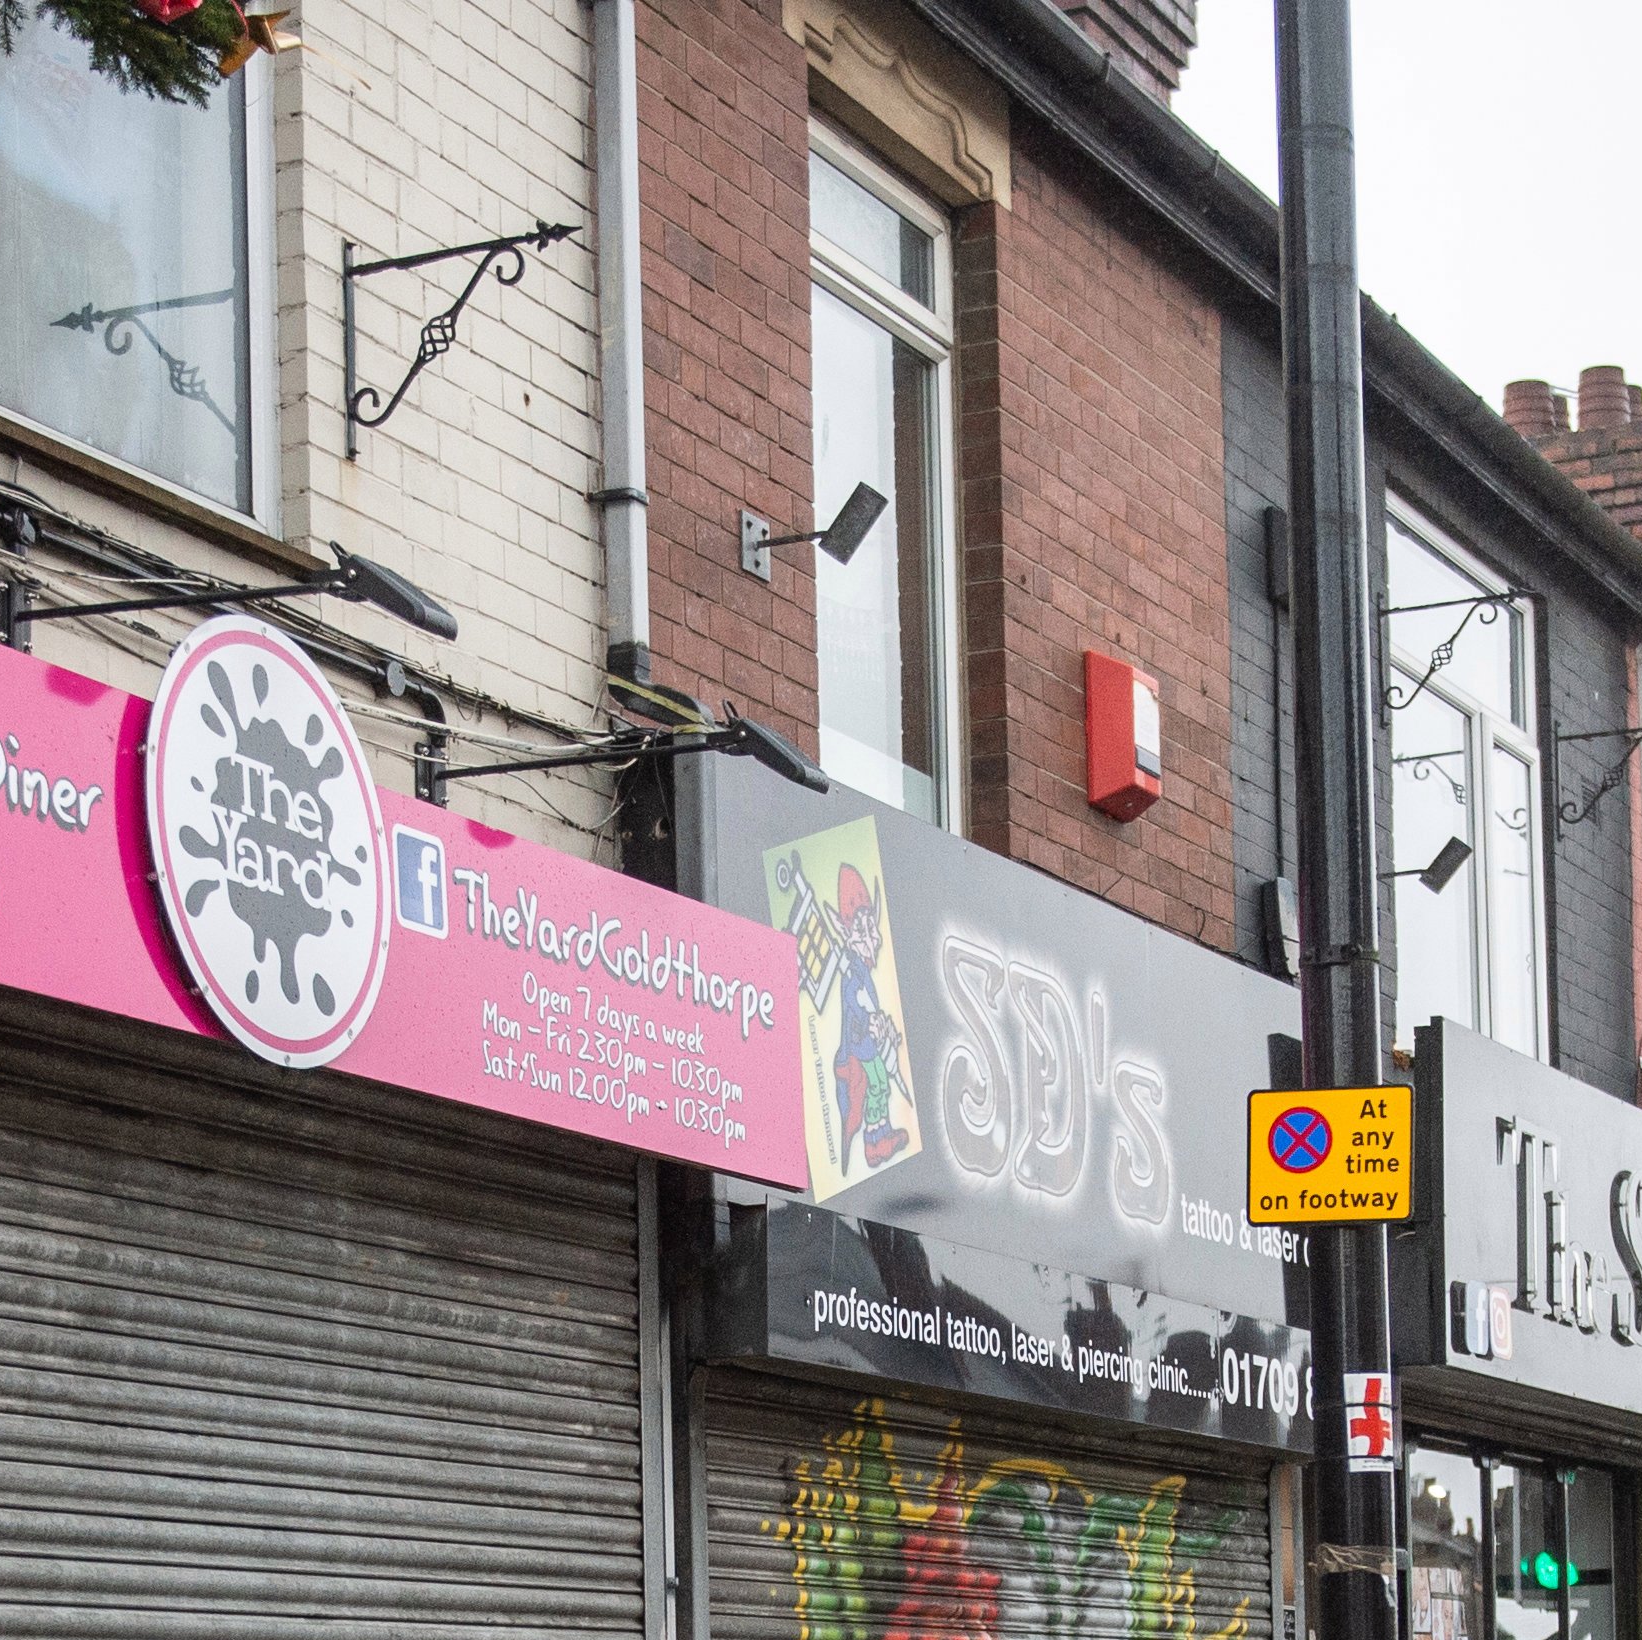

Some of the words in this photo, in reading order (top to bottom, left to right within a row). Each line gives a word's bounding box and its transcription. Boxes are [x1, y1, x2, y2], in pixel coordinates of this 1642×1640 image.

[230, 753, 323, 842] The
[211, 803, 333, 912] Yard
[454, 869, 774, 1039] TheYardGoldthorpe
[482, 999, 520, 1041] Mon
[546, 1016, 571, 1055] Fri
[672, 1057, 743, 1110] 10.30pm
[523, 971, 571, 1019] Open
[577, 986, 591, 1021] 7
[597, 995, 639, 1044] days
[645, 1020, 657, 1041] a
[662, 1023, 705, 1055] week
[482, 1040, 562, 1093] Sat/Sun
[675, 1097, 746, 1148] 10.30pm
[1360, 1099, 1388, 1119] At
[1345, 1154, 1400, 1174] time
[1352, 1131, 1394, 1150] any
[1180, 1193, 1234, 1246] tattoo
[1239, 1208, 1254, 1252] &
[1257, 1226, 1300, 1265] laser
[1260, 1195, 1288, 1211] on
[1299, 1189, 1398, 1211] footway
[1496, 1115, 1612, 1338] The
[813, 1286, 942, 1345] professional
[947, 1311, 1007, 1367] tattoo,
[1011, 1330, 1055, 1368] laser
[1060, 1334, 1074, 1371] &
[1078, 1340, 1144, 1394] piercing
[1223, 1347, 1300, 1417] 01709
